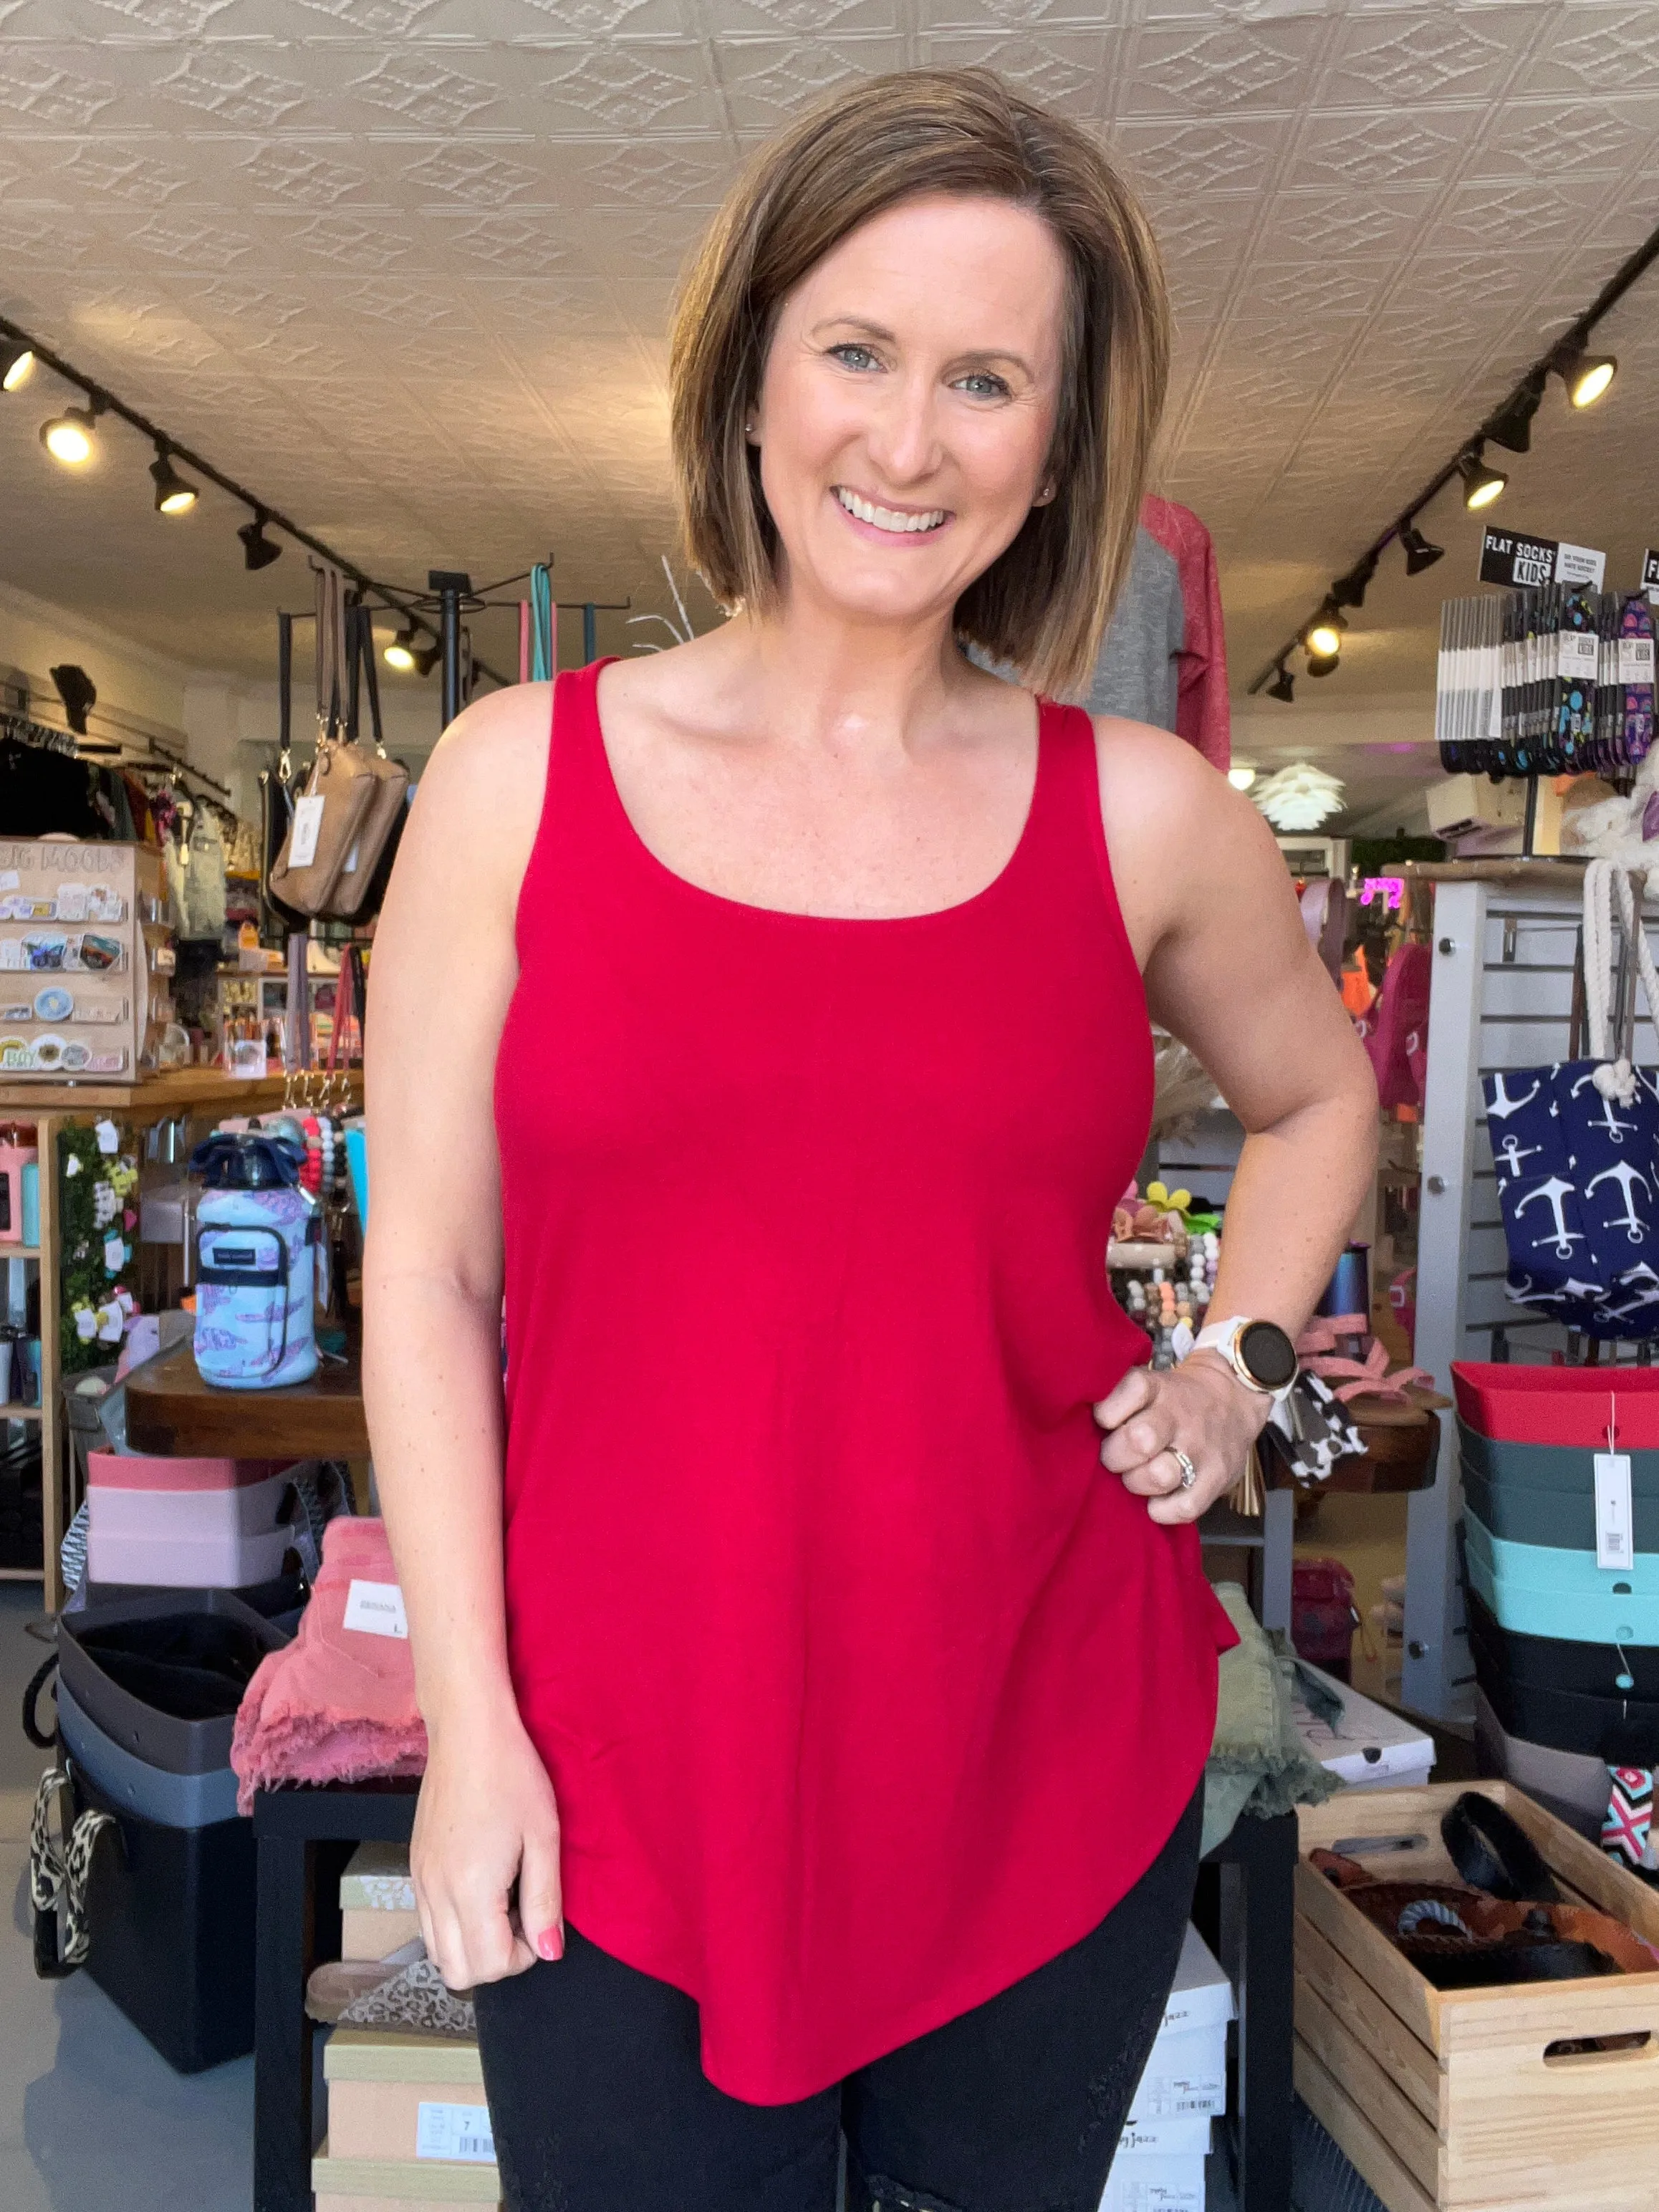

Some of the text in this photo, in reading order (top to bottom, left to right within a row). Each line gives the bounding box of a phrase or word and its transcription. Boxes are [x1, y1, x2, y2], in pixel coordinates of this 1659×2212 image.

[1485, 535, 1553, 563] FLAT SOCKS
[1517, 560, 1547, 585] KIDS
[464, 2120, 470, 2131] 7
